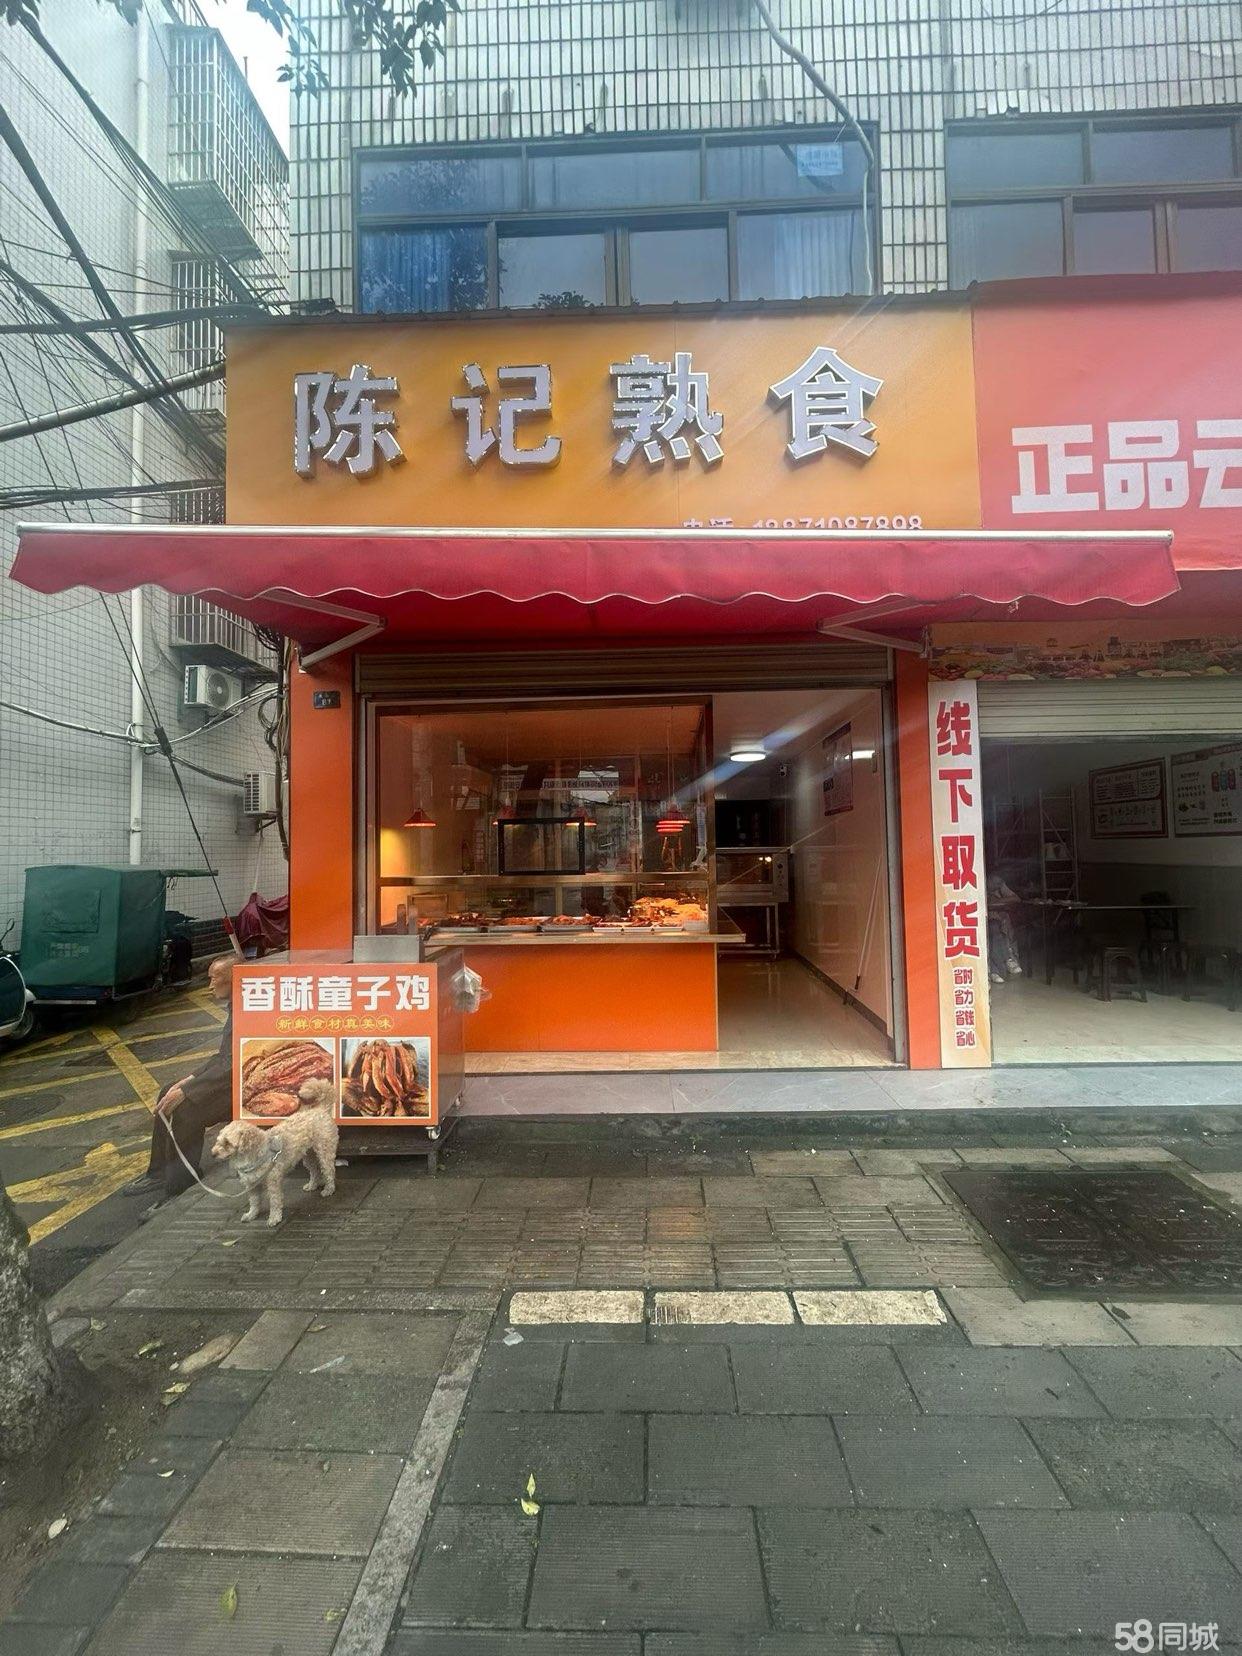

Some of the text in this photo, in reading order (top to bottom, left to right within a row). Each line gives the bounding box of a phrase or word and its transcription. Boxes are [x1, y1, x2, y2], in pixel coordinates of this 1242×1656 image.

[293, 346, 885, 478] 陈记熟食
[1011, 419, 1242, 513] 正品云
[936, 701, 980, 958] 线下取货
[241, 975, 430, 1012] 香酥童子鸡
[954, 989, 974, 1006] 省力
[956, 1030, 976, 1047] 省心
